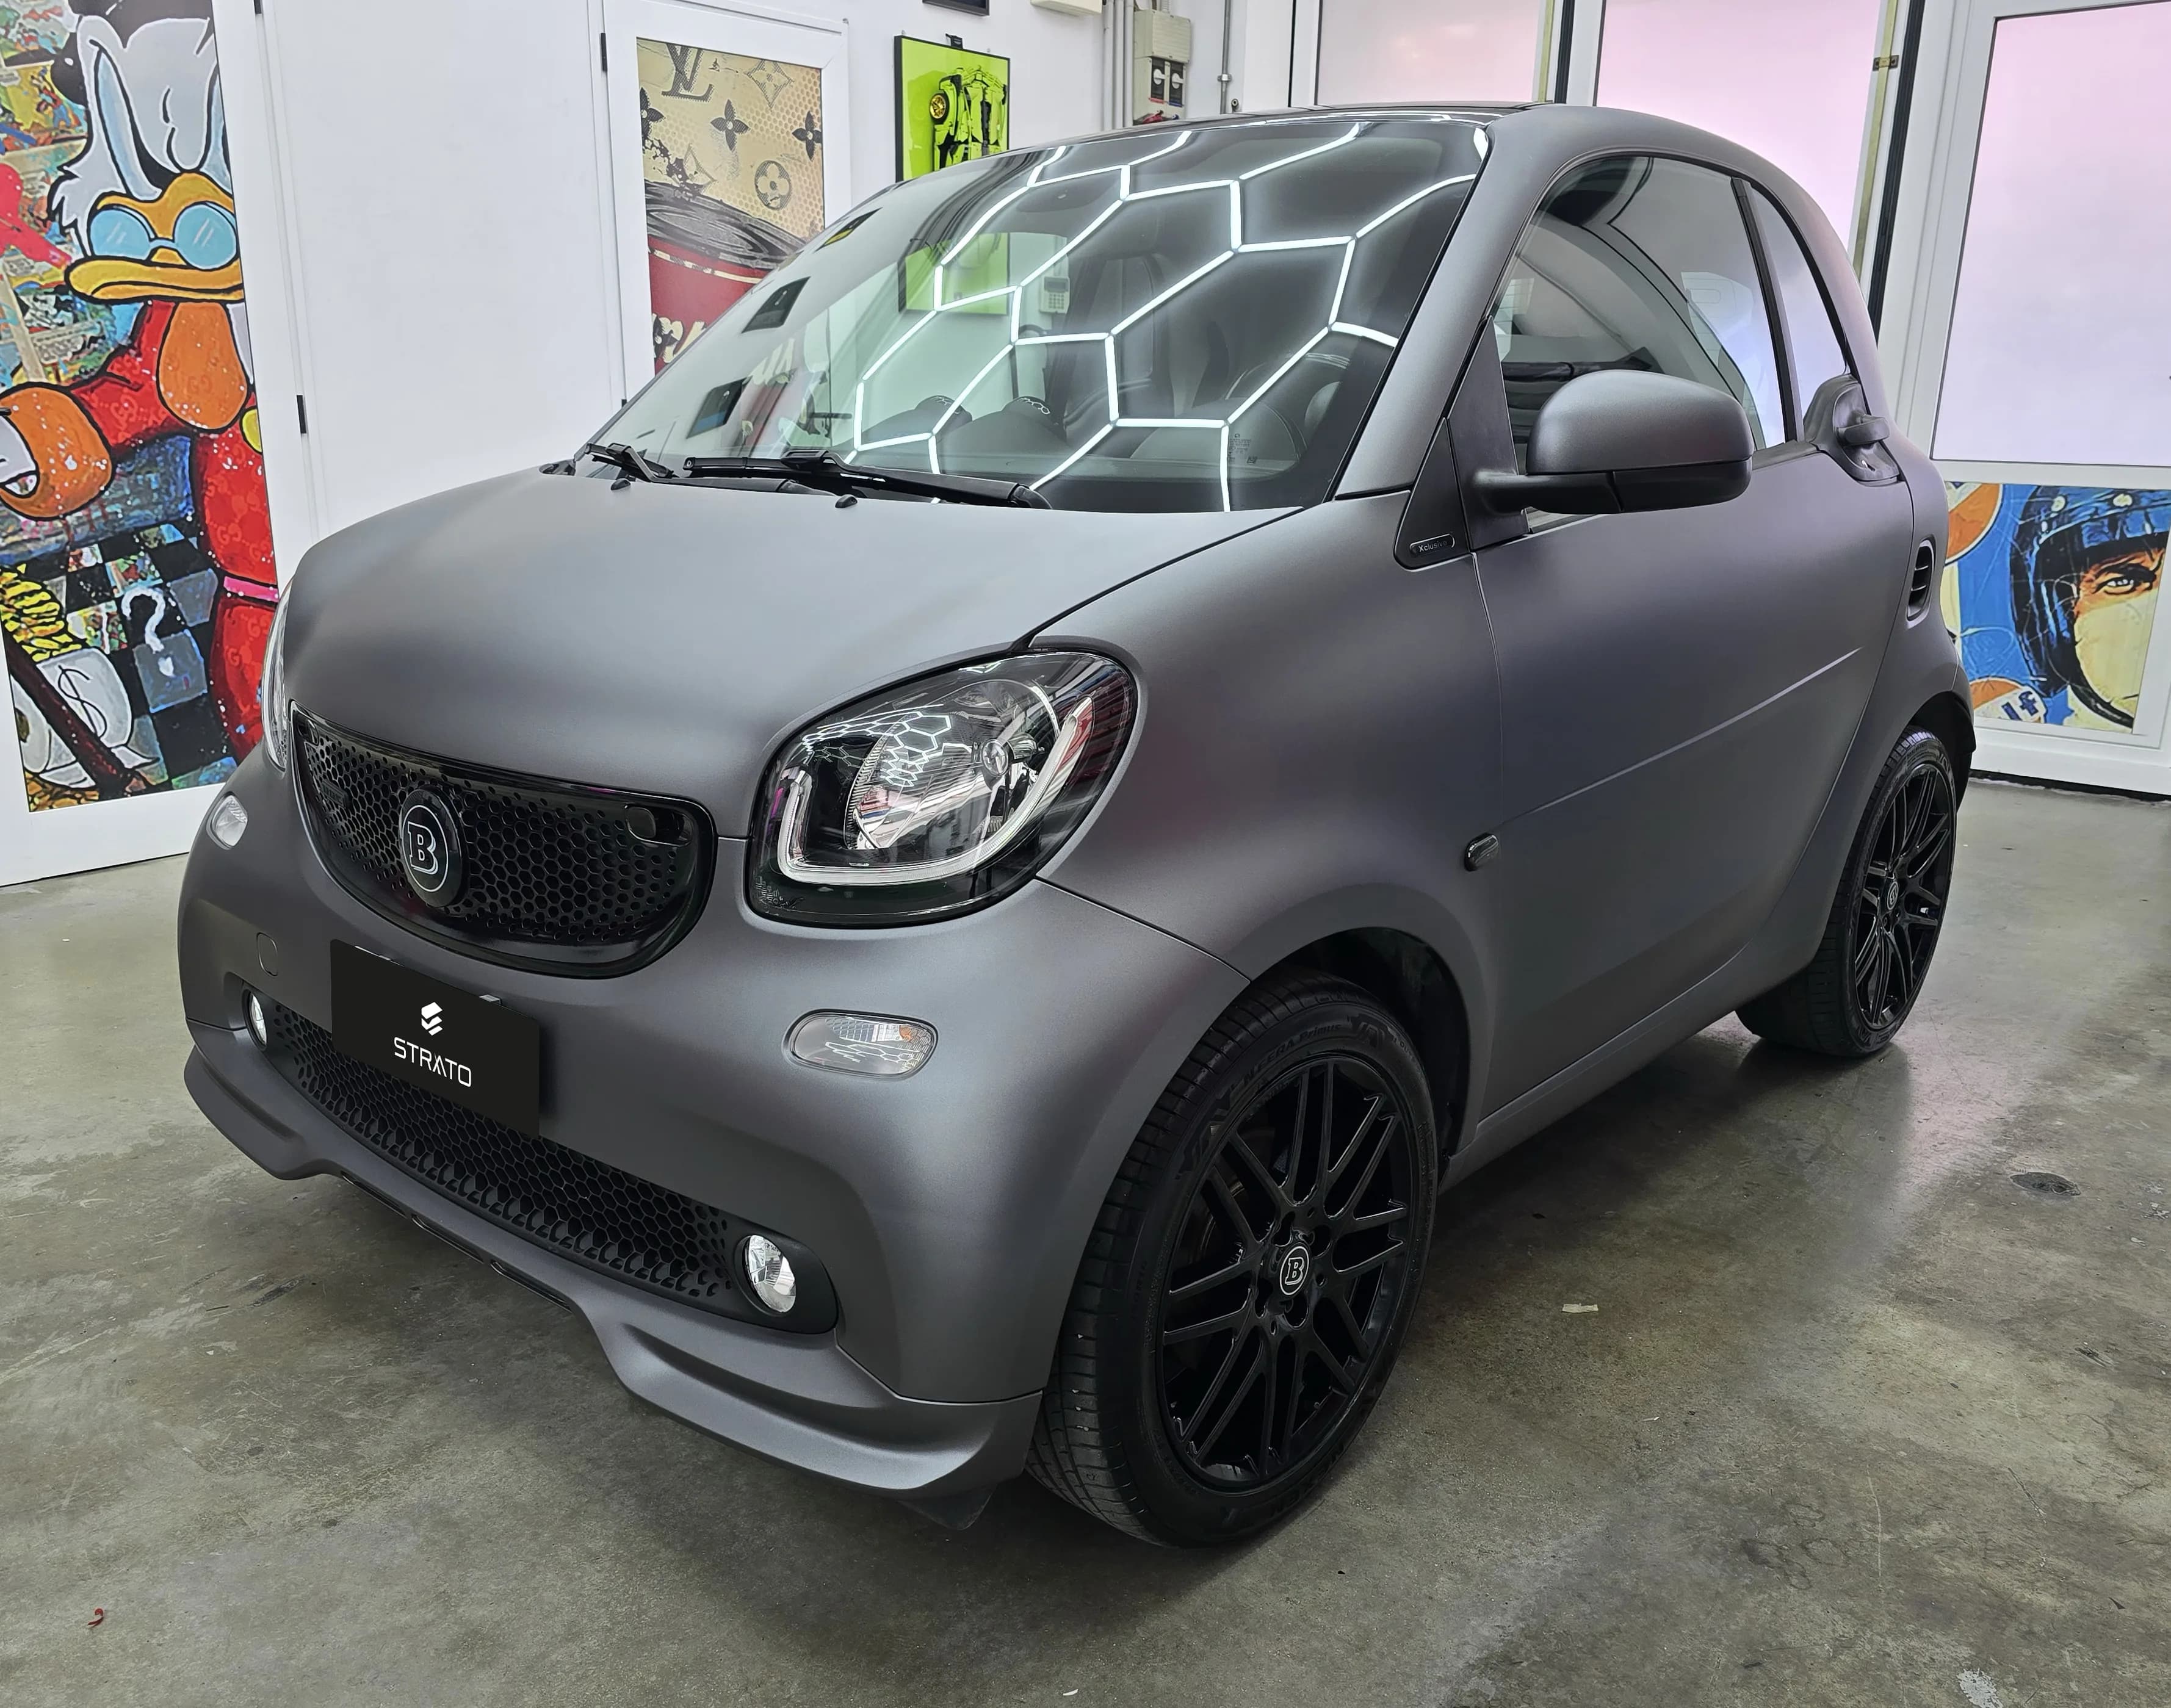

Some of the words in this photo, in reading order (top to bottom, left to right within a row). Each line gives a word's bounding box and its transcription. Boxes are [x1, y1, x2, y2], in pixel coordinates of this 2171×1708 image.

[407, 821, 439, 875] B
[394, 1037, 472, 1088] STRATO
[1284, 1256, 1305, 1286] B
